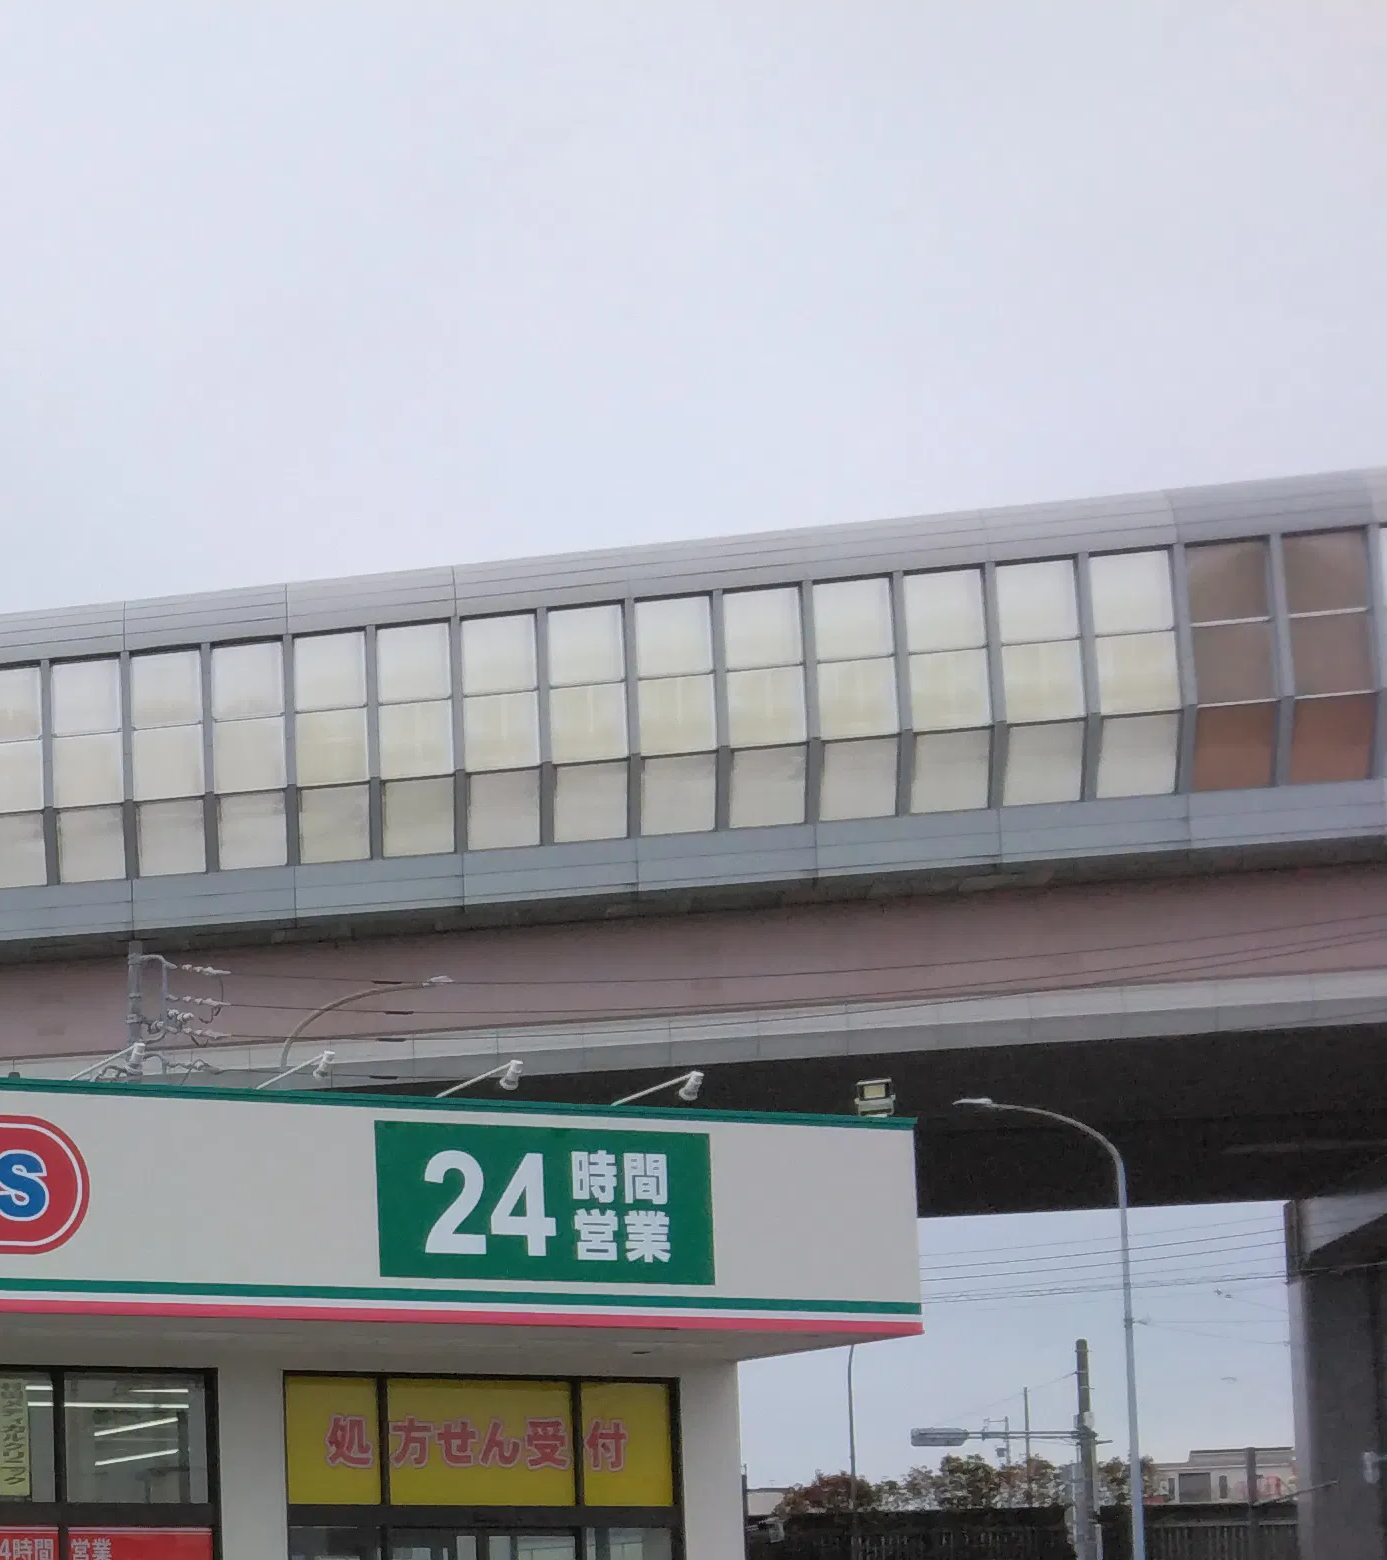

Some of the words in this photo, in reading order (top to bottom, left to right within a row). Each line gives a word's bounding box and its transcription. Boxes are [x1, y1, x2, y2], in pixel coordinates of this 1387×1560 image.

[424, 1150, 556, 1257] 24
[571, 1150, 668, 1205] 時間
[573, 1209, 671, 1263] 営業
[328, 1415, 627, 1470] 処方せん受付
